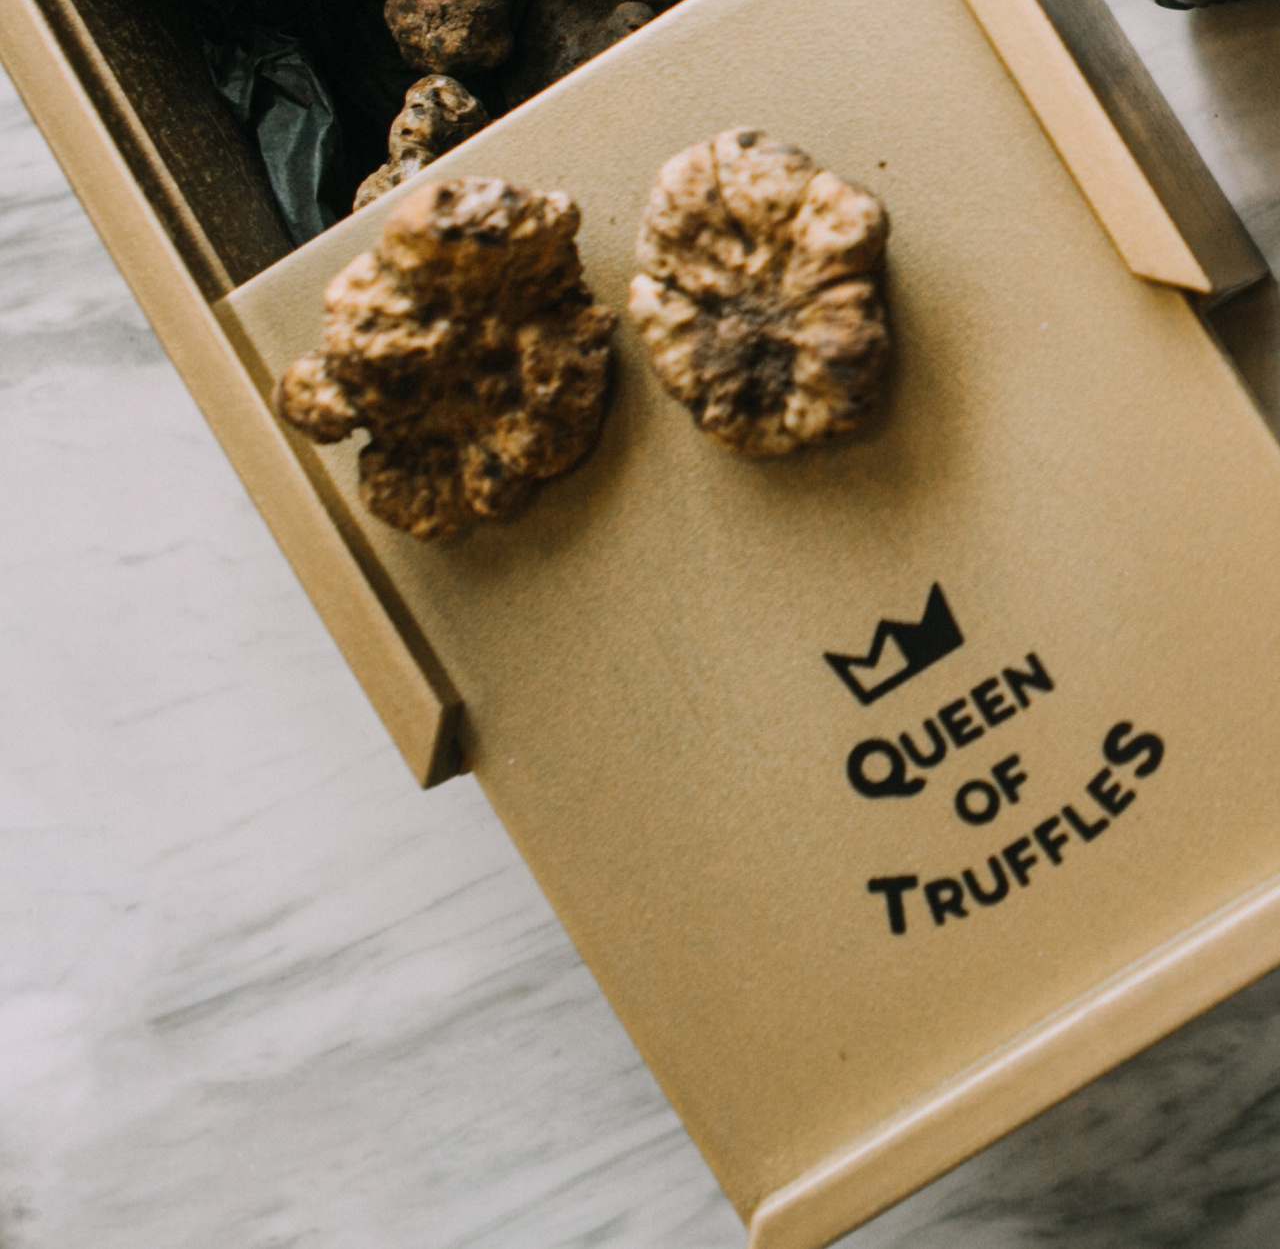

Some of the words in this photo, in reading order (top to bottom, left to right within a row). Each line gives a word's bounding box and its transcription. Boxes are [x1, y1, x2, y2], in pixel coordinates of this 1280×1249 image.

[846, 652, 1056, 799] QUEEN
[954, 753, 1028, 826] OF
[866, 720, 1165, 935] TRUFFLES
